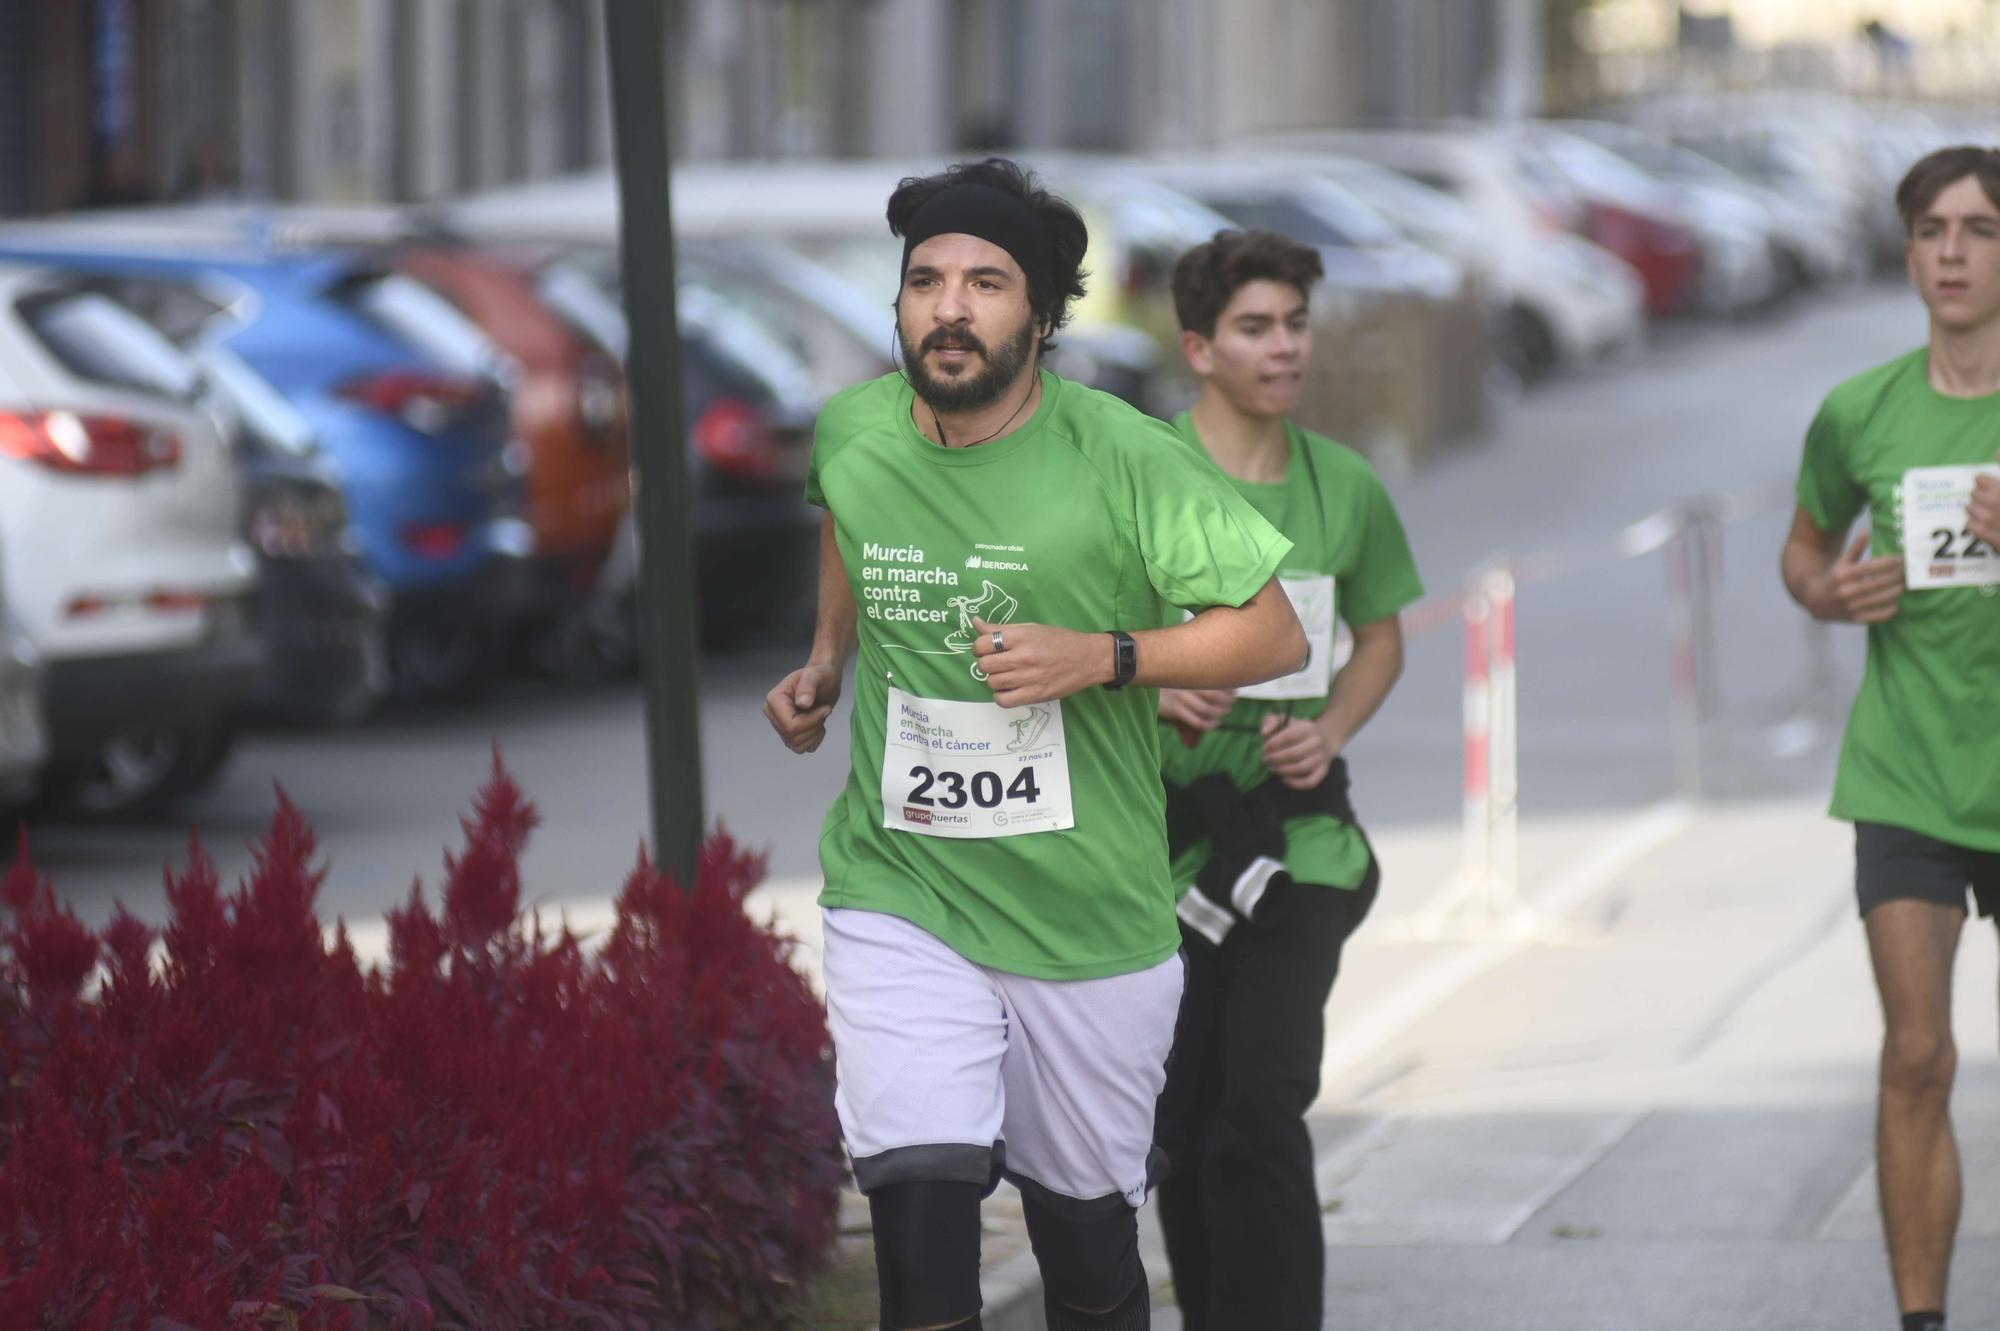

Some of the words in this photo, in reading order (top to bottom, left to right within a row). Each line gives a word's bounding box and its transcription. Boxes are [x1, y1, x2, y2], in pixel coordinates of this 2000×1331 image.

[863, 542, 924, 563] Murcia
[982, 560, 1028, 571] IBERDROLA
[862, 566, 882, 581] en
[887, 566, 958, 586] marcha
[863, 585, 920, 603] contra
[866, 602, 882, 620] el
[884, 603, 949, 623] cáncer
[900, 704, 929, 723] Murcia
[900, 718, 914, 730] en
[915, 723, 953, 738] marcha
[899, 731, 930, 748] contra
[931, 739, 943, 749] el
[946, 739, 991, 750] cáncer
[907, 765, 1041, 810] 2304
